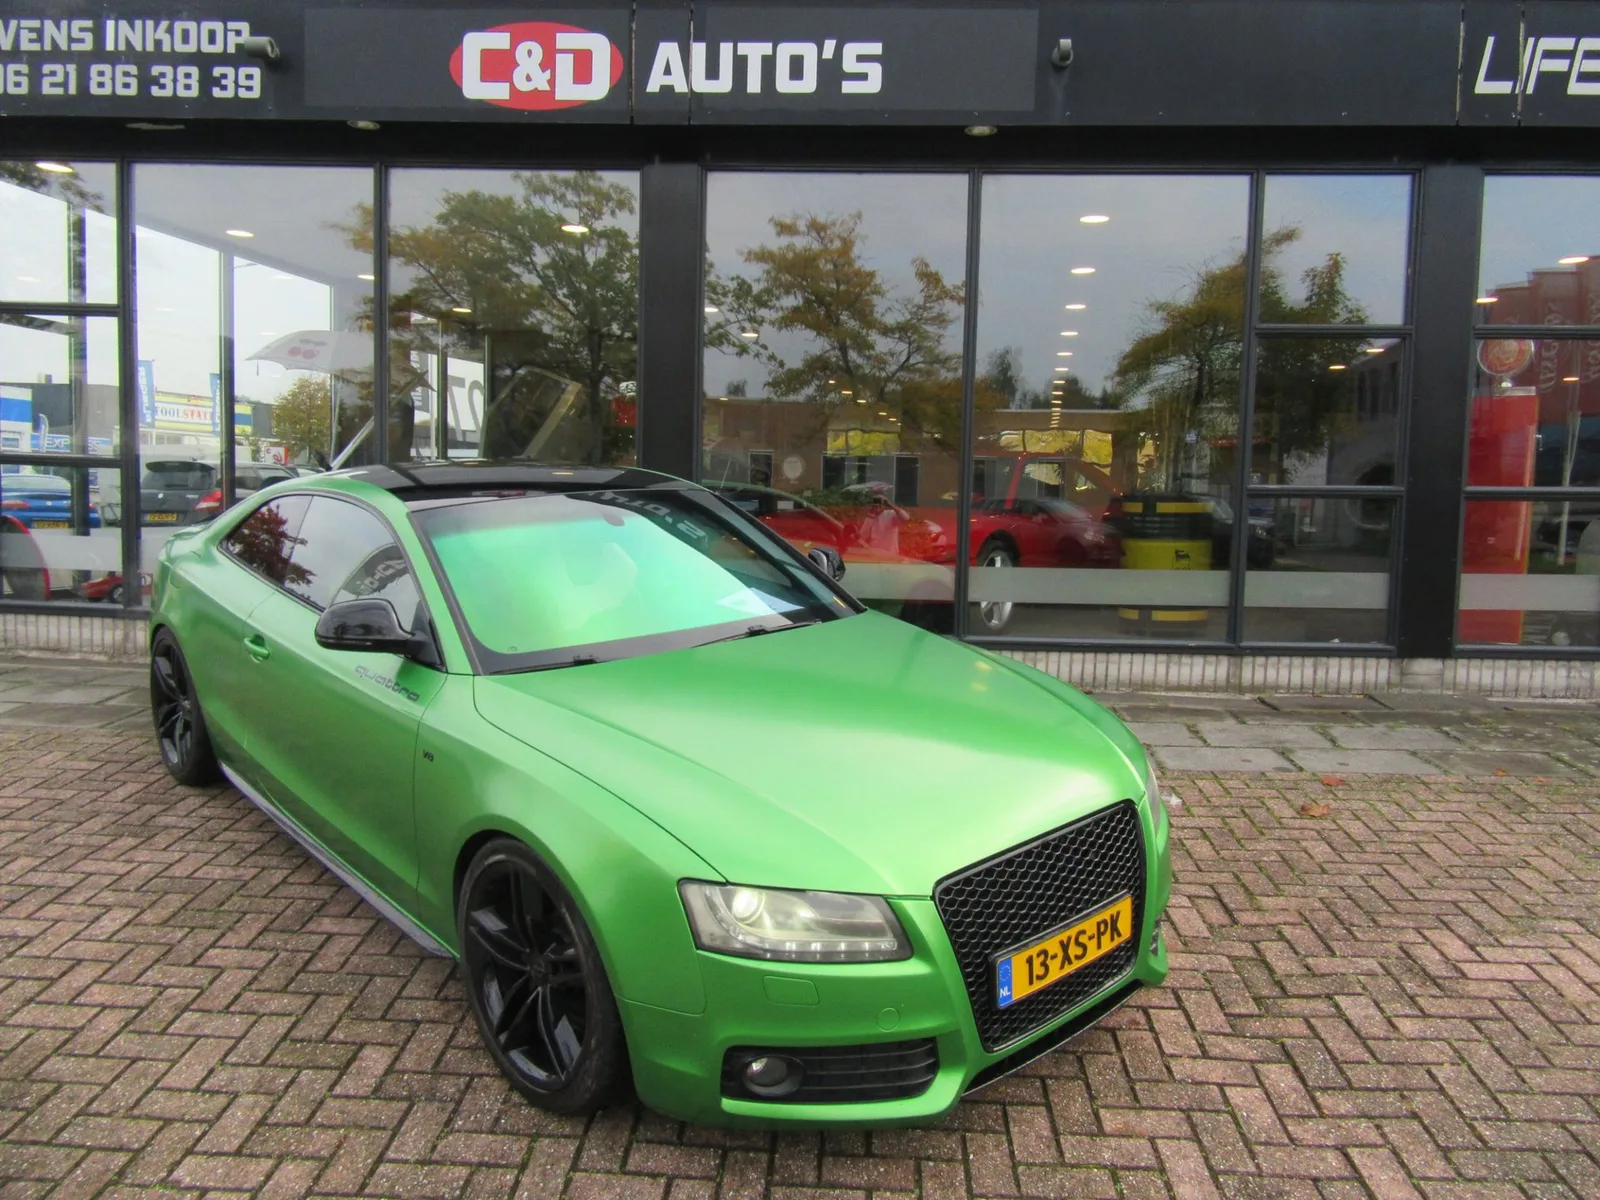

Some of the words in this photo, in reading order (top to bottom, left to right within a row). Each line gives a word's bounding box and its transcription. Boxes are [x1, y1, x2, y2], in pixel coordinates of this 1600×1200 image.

[105, 20, 250, 53] INKOOP
[0, 64, 29, 95] 6
[42, 64, 77, 95] 21
[89, 64, 138, 96] 86
[151, 65, 199, 97] 38
[212, 66, 261, 99] 39
[462, 31, 611, 101] C&D
[646, 39, 882, 94] AUTO'S
[1000, 986, 1011, 998] NL
[1025, 910, 1123, 986] 13-XS-PK
